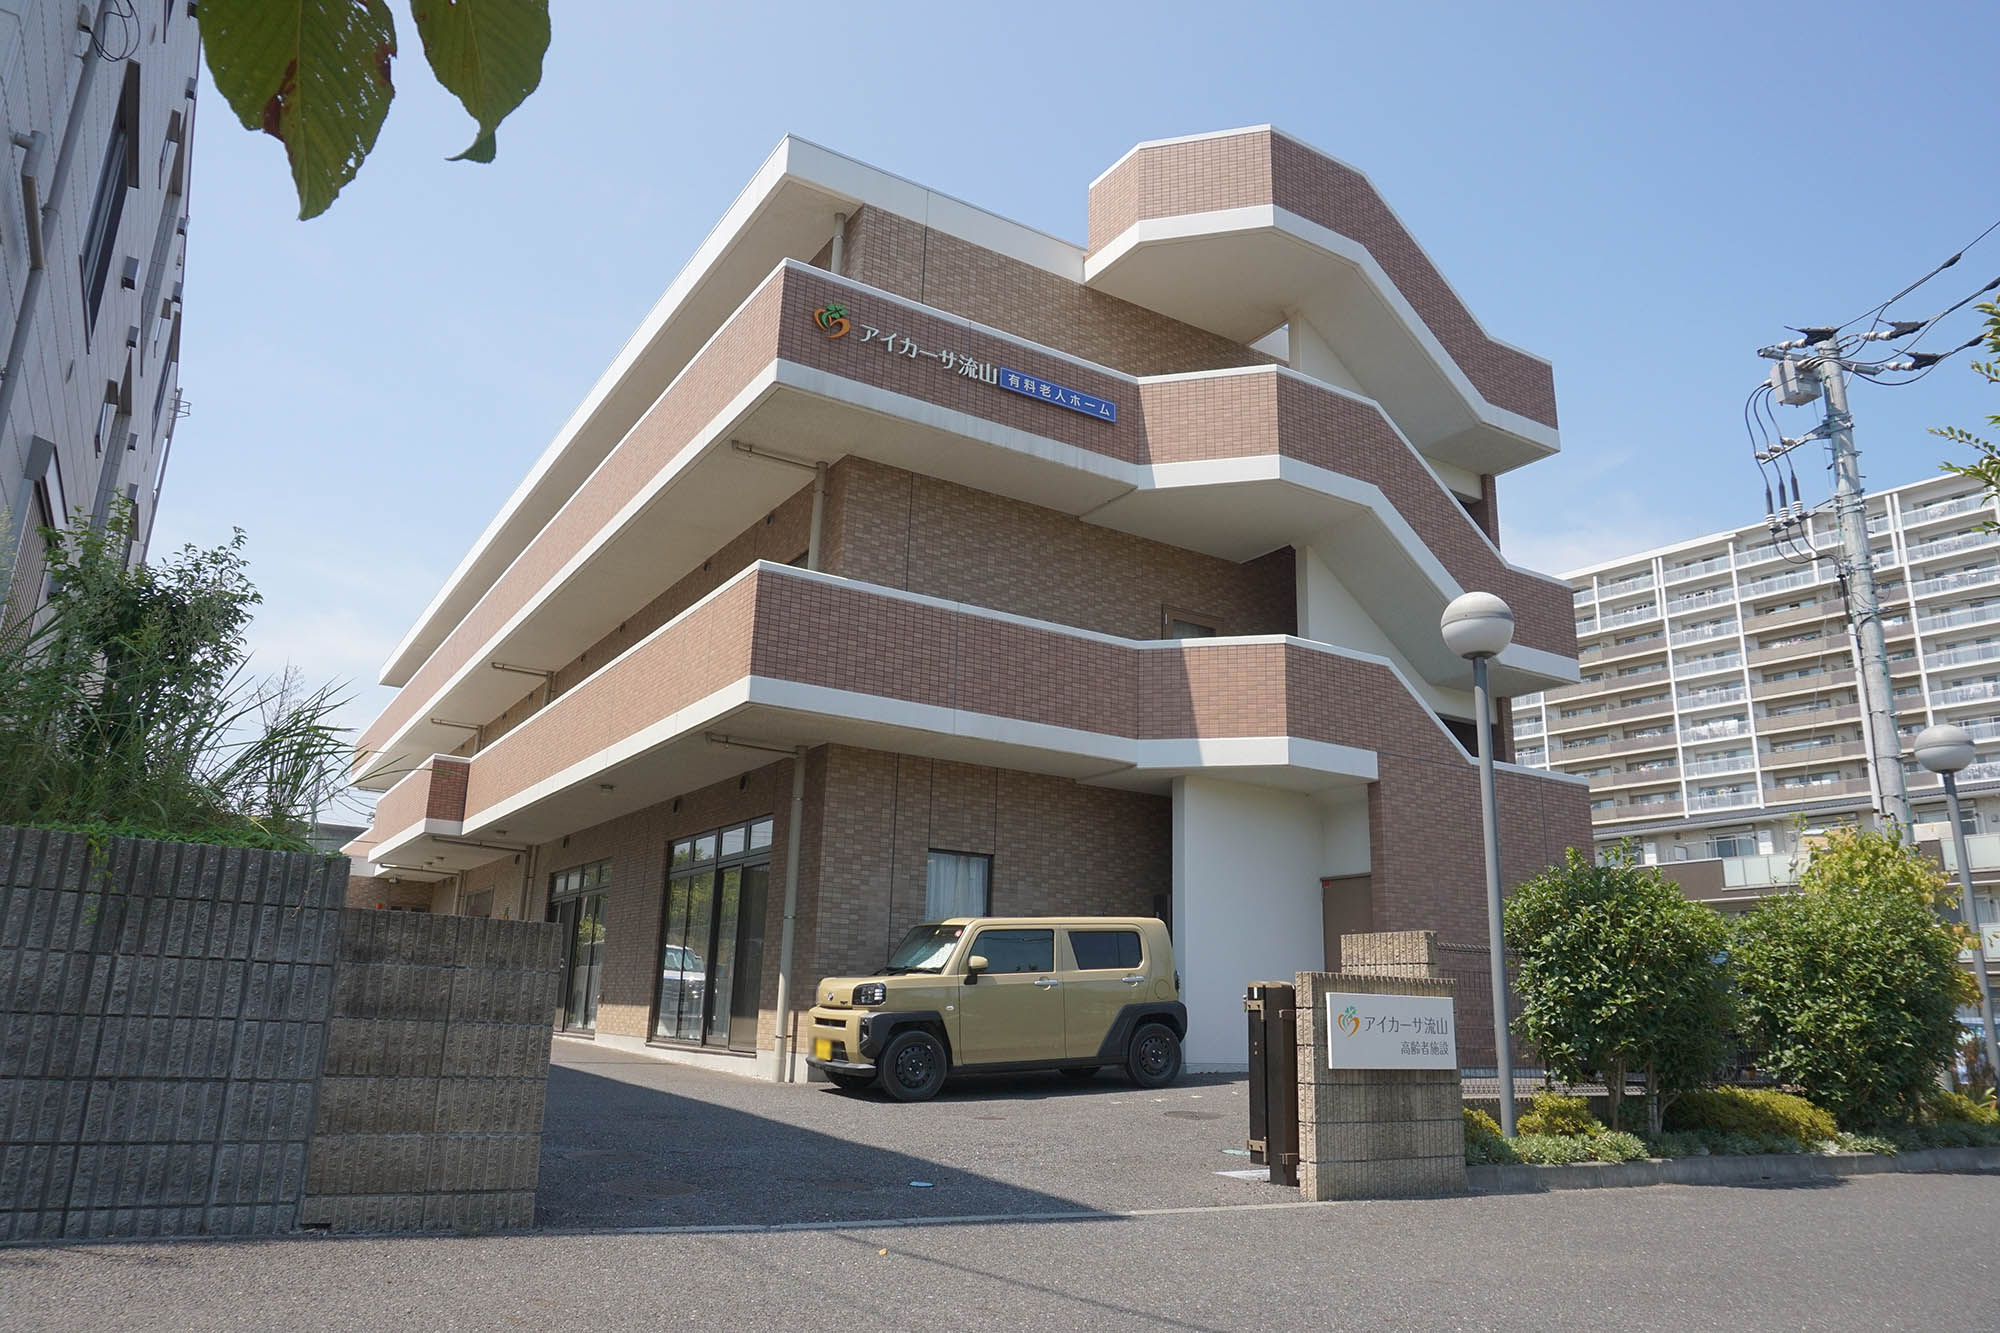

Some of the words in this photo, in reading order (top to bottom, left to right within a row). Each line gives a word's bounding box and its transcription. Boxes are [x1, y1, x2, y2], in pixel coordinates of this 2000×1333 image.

[860, 324, 997, 384] アイカーサ流山
[1008, 373, 1110, 416] 有料老人ホーム
[1364, 1016, 1448, 1034] アイカーサ流山
[1400, 1041, 1449, 1055] 高齢者施設
